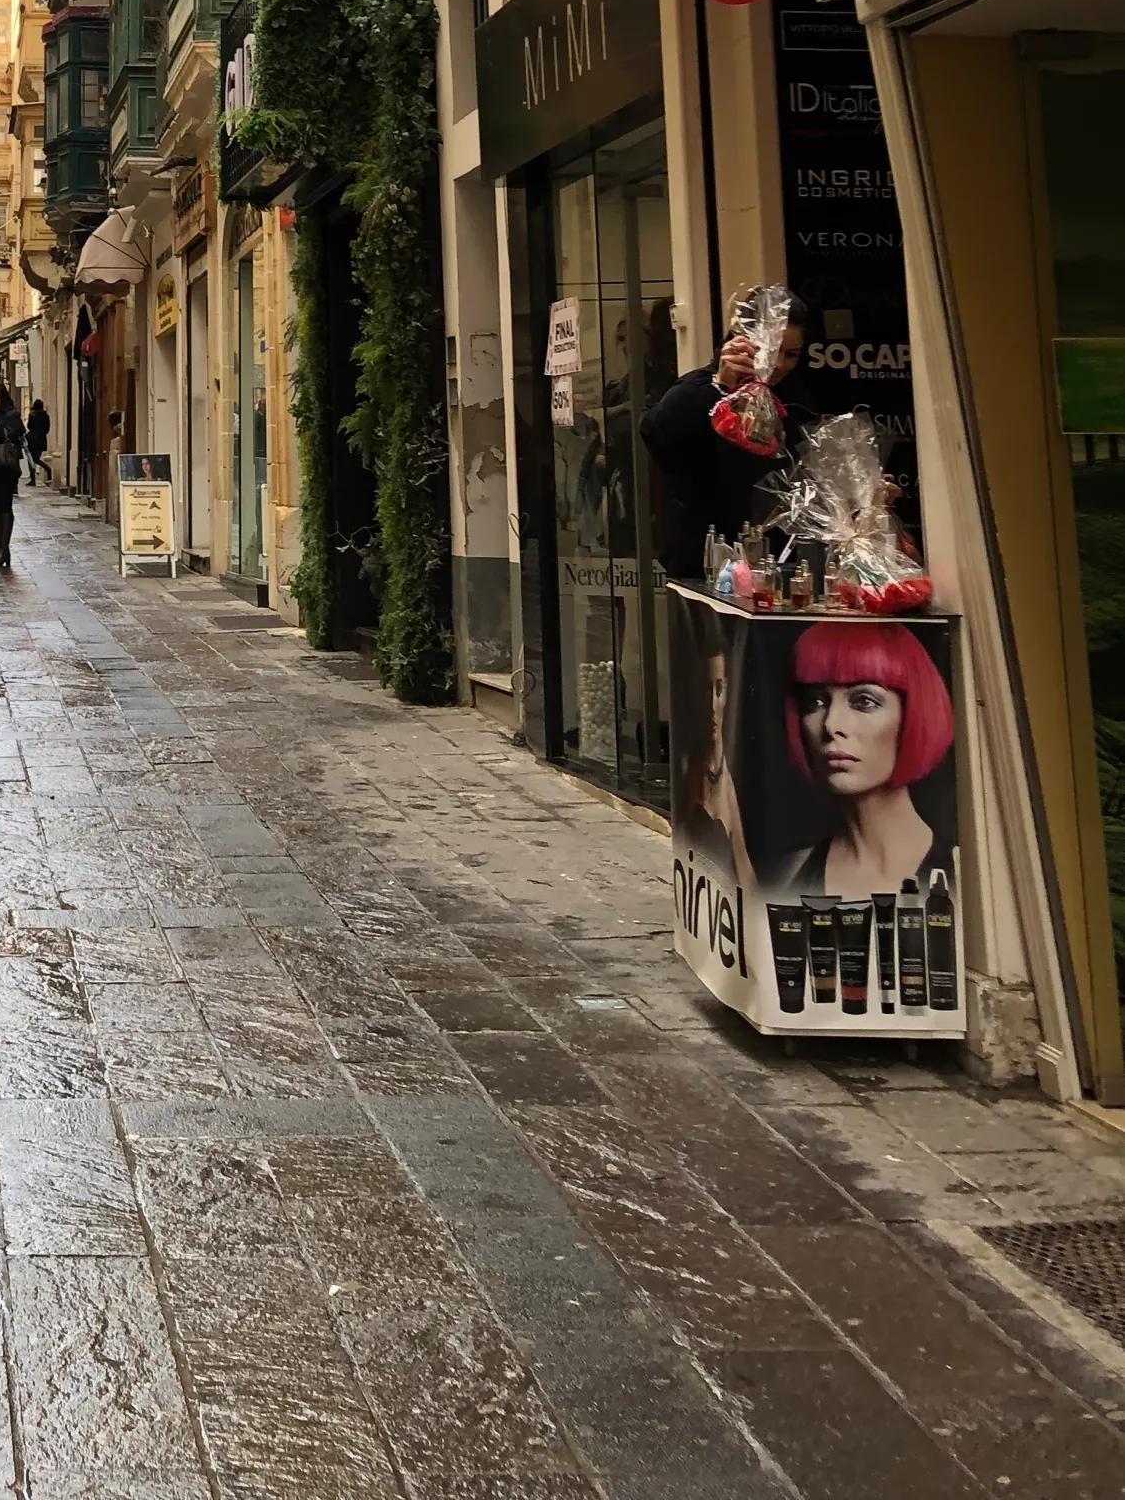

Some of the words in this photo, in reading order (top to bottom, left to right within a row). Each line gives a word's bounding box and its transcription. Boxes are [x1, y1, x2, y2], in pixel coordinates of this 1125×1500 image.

[789, 81, 821, 113] ID
[822, 90, 882, 114] Italia
[797, 186, 893, 199] COSMETIC
[796, 232, 904, 248] VERON
[555, 318, 575, 342] FINAL
[673, 849, 749, 979] nirvel
